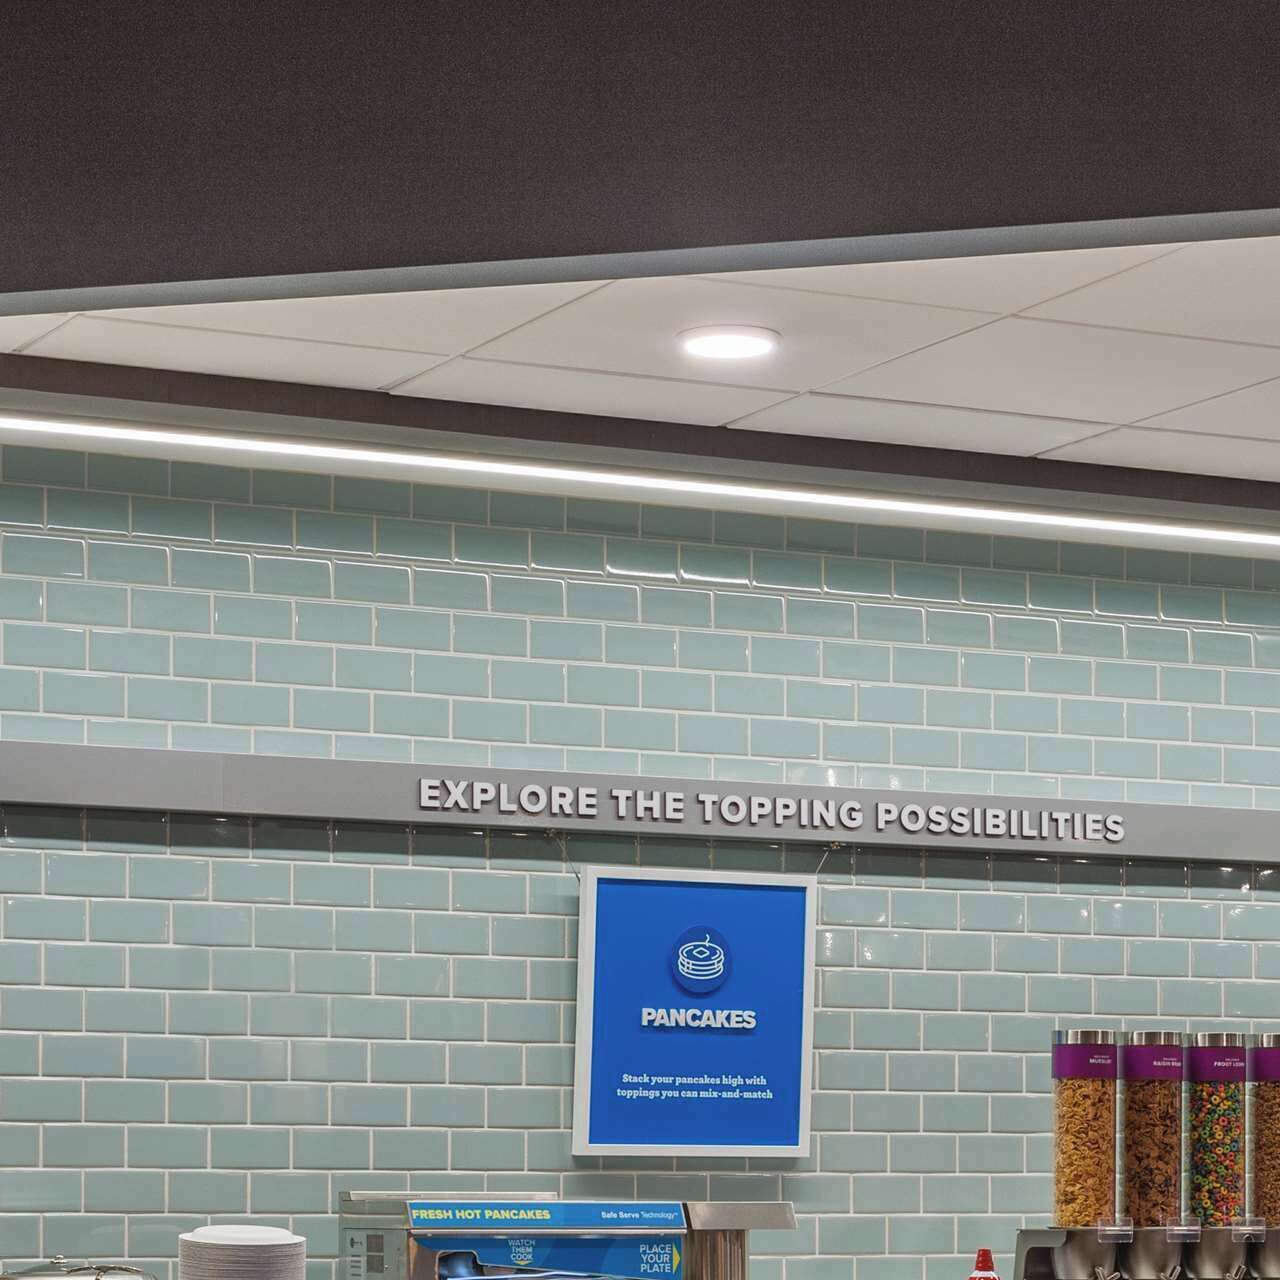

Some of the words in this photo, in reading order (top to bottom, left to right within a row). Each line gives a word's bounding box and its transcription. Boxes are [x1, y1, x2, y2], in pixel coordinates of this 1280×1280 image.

[419, 778, 598, 816] EXPLORE
[610, 788, 685, 820] THE
[697, 793, 864, 829] TOPPING
[876, 802, 1125, 842] POSSIBILITIES
[641, 1007, 757, 1029] PANCAKES
[622, 1073, 650, 1083] Stack
[650, 1075, 674, 1086] your
[675, 1074, 721, 1086] pancakes
[722, 1074, 744, 1087] high
[745, 1074, 767, 1086] with
[616, 1087, 660, 1099] toppings
[660, 1089, 679, 1099] you
[680, 1090, 698, 1098] can
[699, 1088, 773, 1099] mix-and-match
[411, 1209, 453, 1219] FRESH
[456, 1209, 481, 1219] HOT
[485, 1209, 551, 1220] PANCAKES
[601, 1211, 618, 1219] Safe
[619, 1211, 639, 1219] Serve
[511, 1246, 533, 1254] THEM
[639, 1244, 671, 1254] PLACE
[510, 1253, 533, 1261] COOK
[641, 1253, 671, 1263] YOUR
[640, 1263, 671, 1273] PLATE
